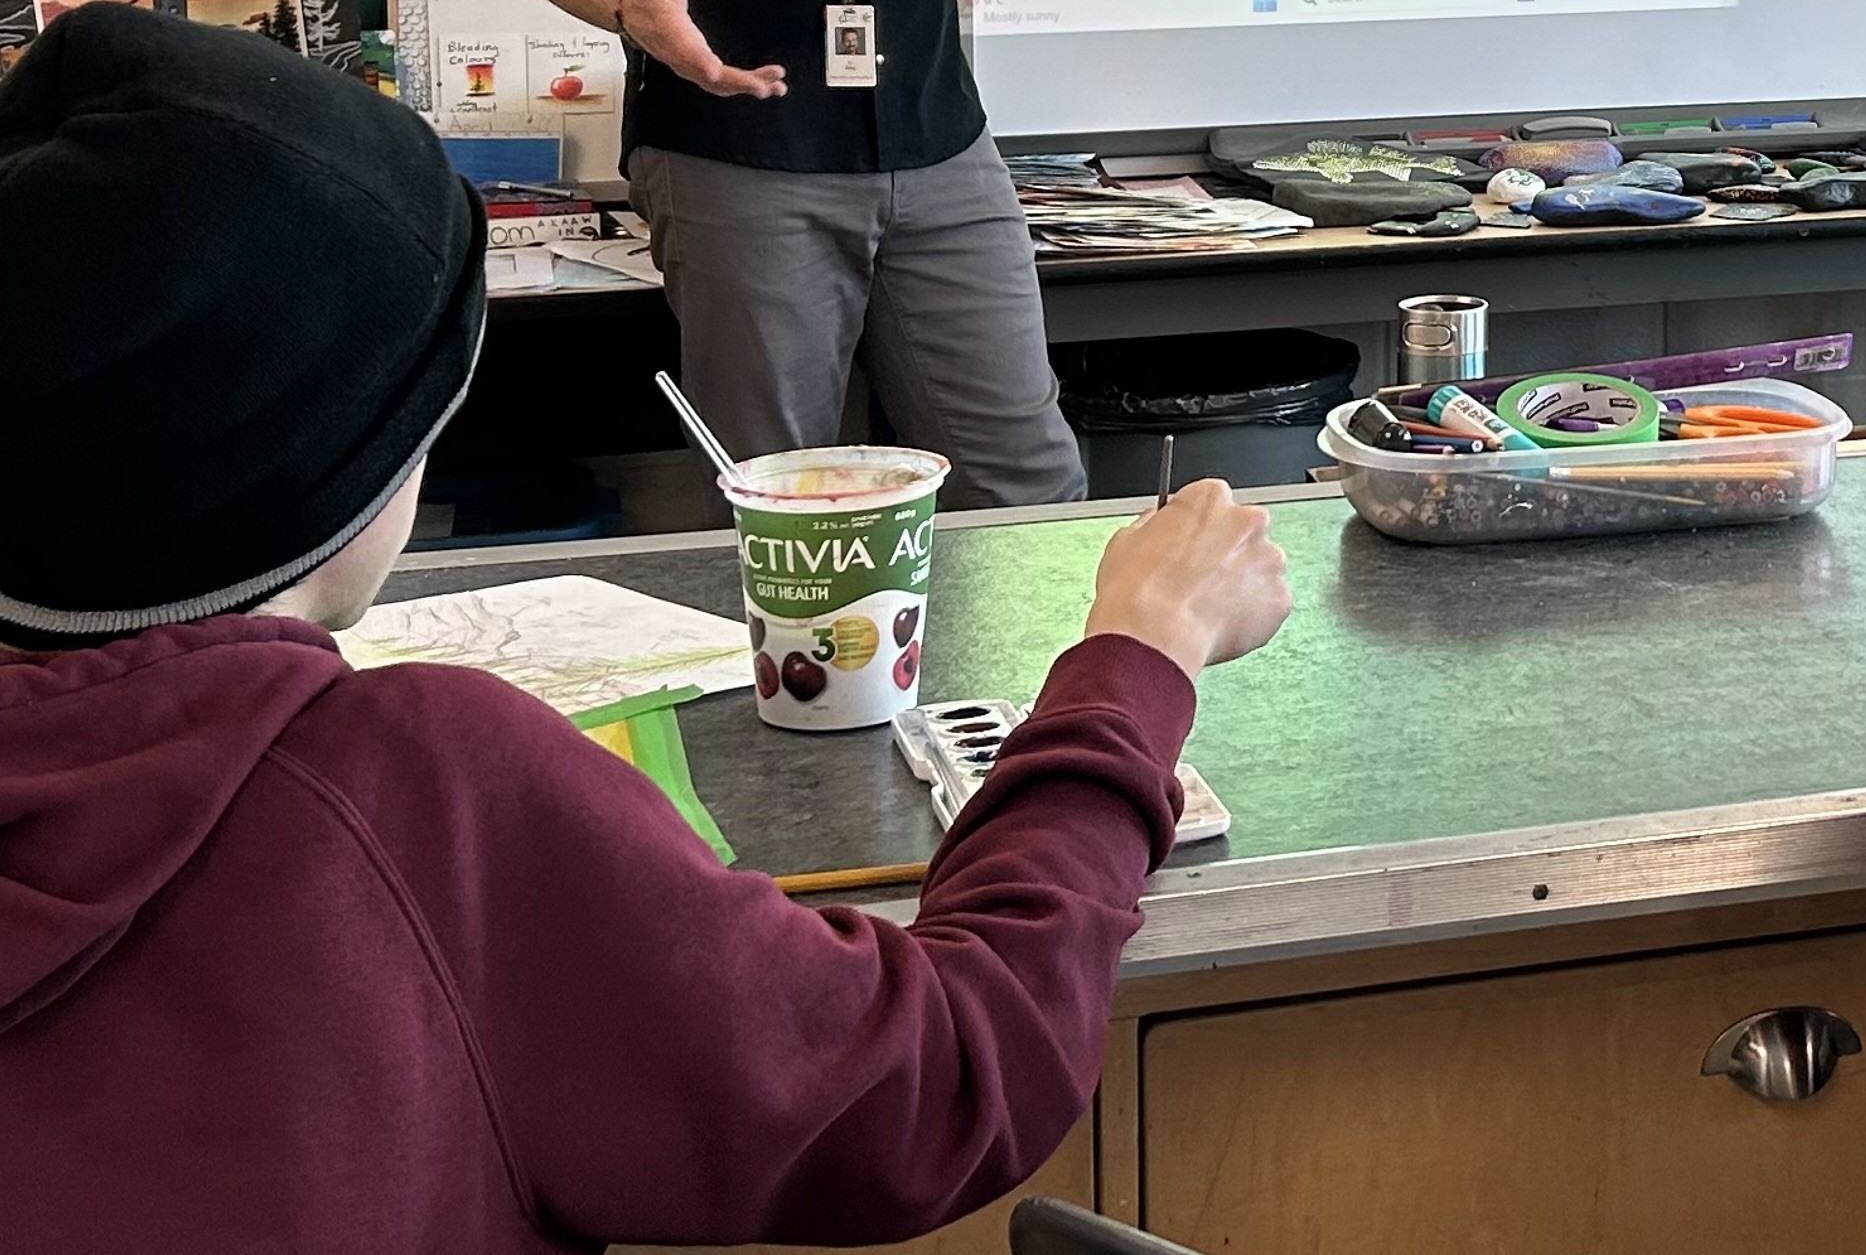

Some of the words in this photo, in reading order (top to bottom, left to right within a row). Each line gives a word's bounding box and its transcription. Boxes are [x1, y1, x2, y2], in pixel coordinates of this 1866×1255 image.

[757, 582, 777, 599] GUT
[778, 585, 829, 601] HEALTH
[811, 627, 836, 662] 3
